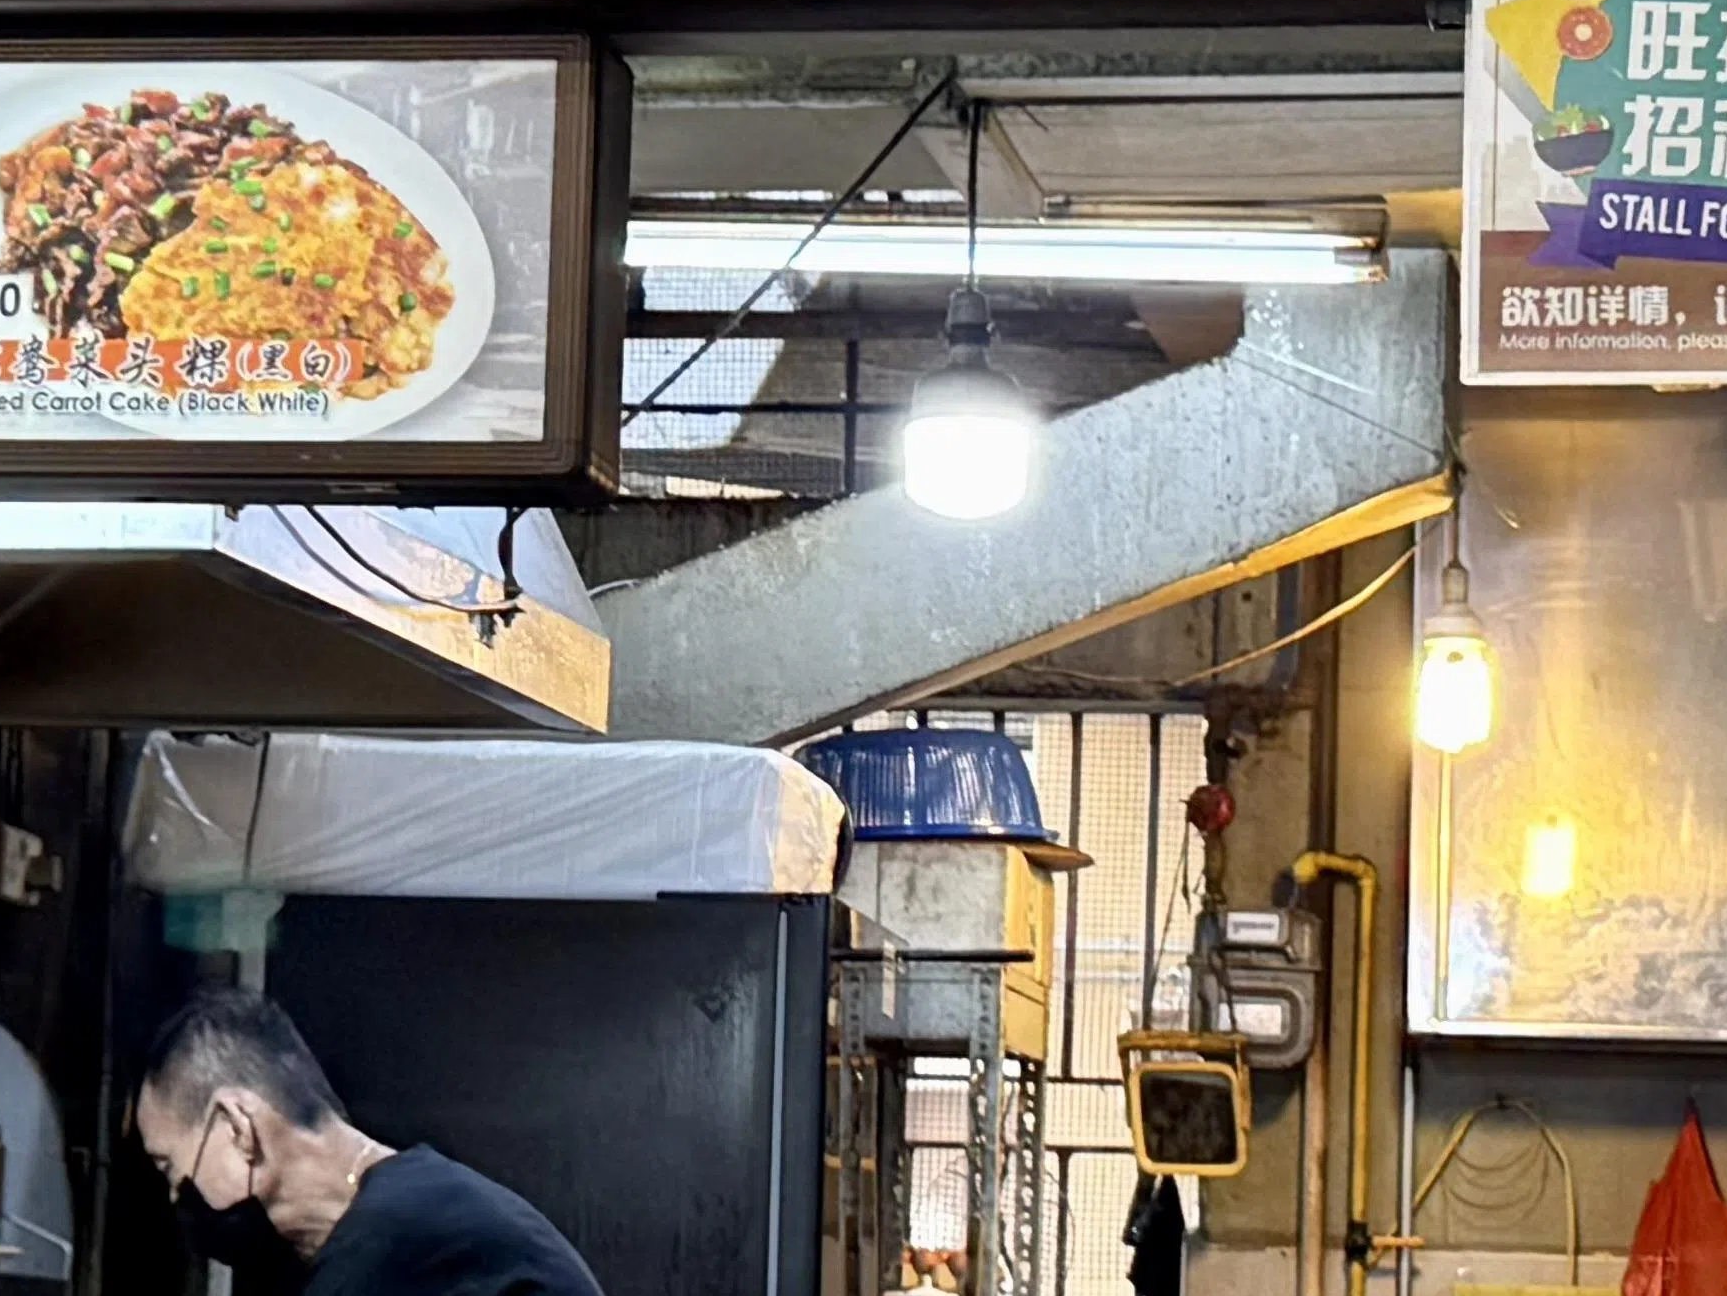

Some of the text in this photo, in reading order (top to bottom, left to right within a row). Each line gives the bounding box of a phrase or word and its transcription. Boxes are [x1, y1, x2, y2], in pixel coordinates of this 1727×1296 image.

[1600, 192, 1692, 238] STALL
[1499, 332, 1549, 349] More
[33, 392, 102, 411] Carrot
[110, 392, 169, 411] Cake
